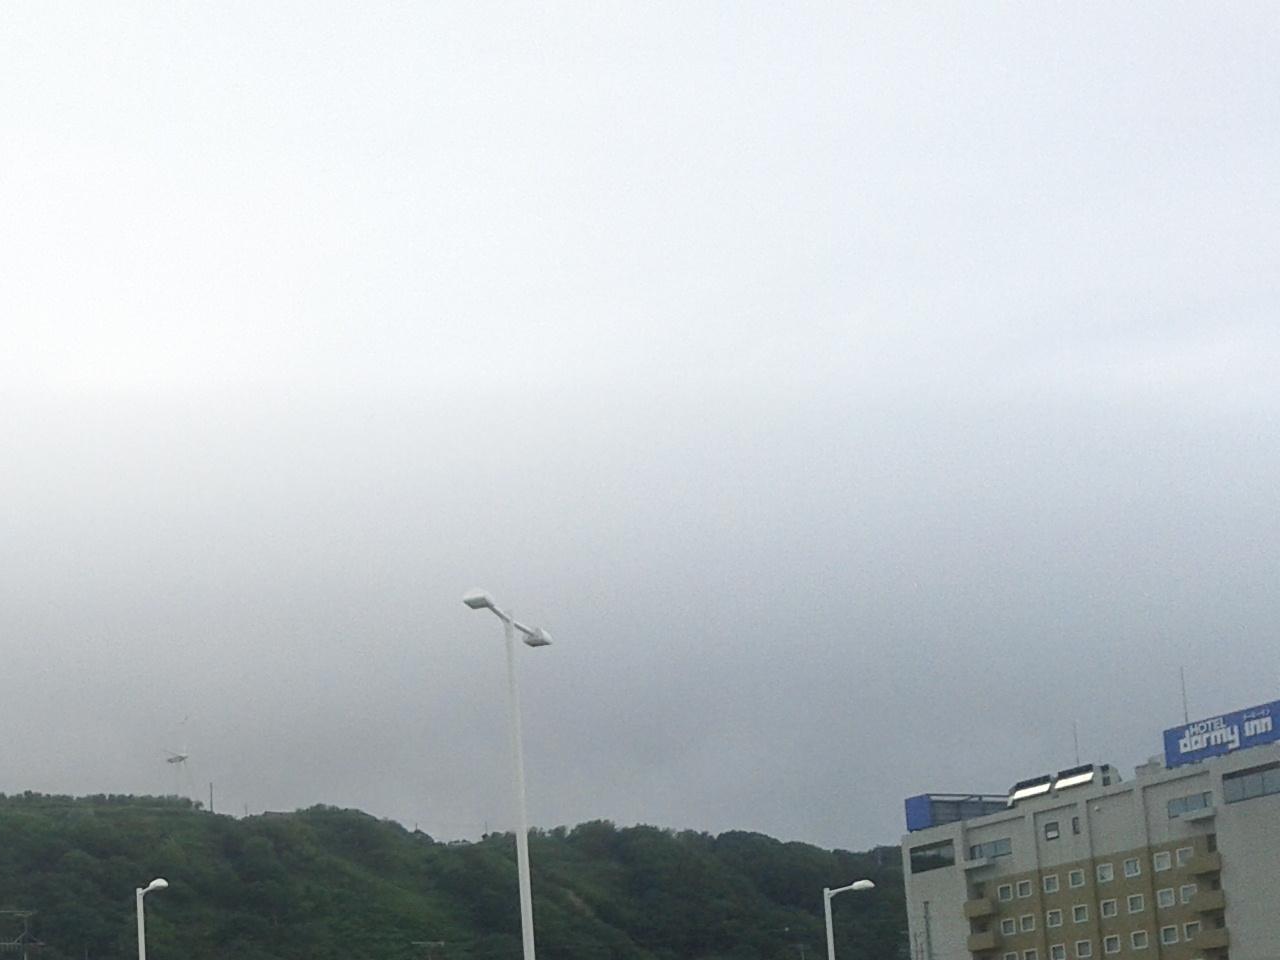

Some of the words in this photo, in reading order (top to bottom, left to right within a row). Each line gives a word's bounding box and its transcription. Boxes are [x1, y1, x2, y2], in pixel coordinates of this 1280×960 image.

[1179, 725, 1240, 754] dormy
[1244, 717, 1272, 737] inn
[1189, 717, 1227, 734] HOTEL
